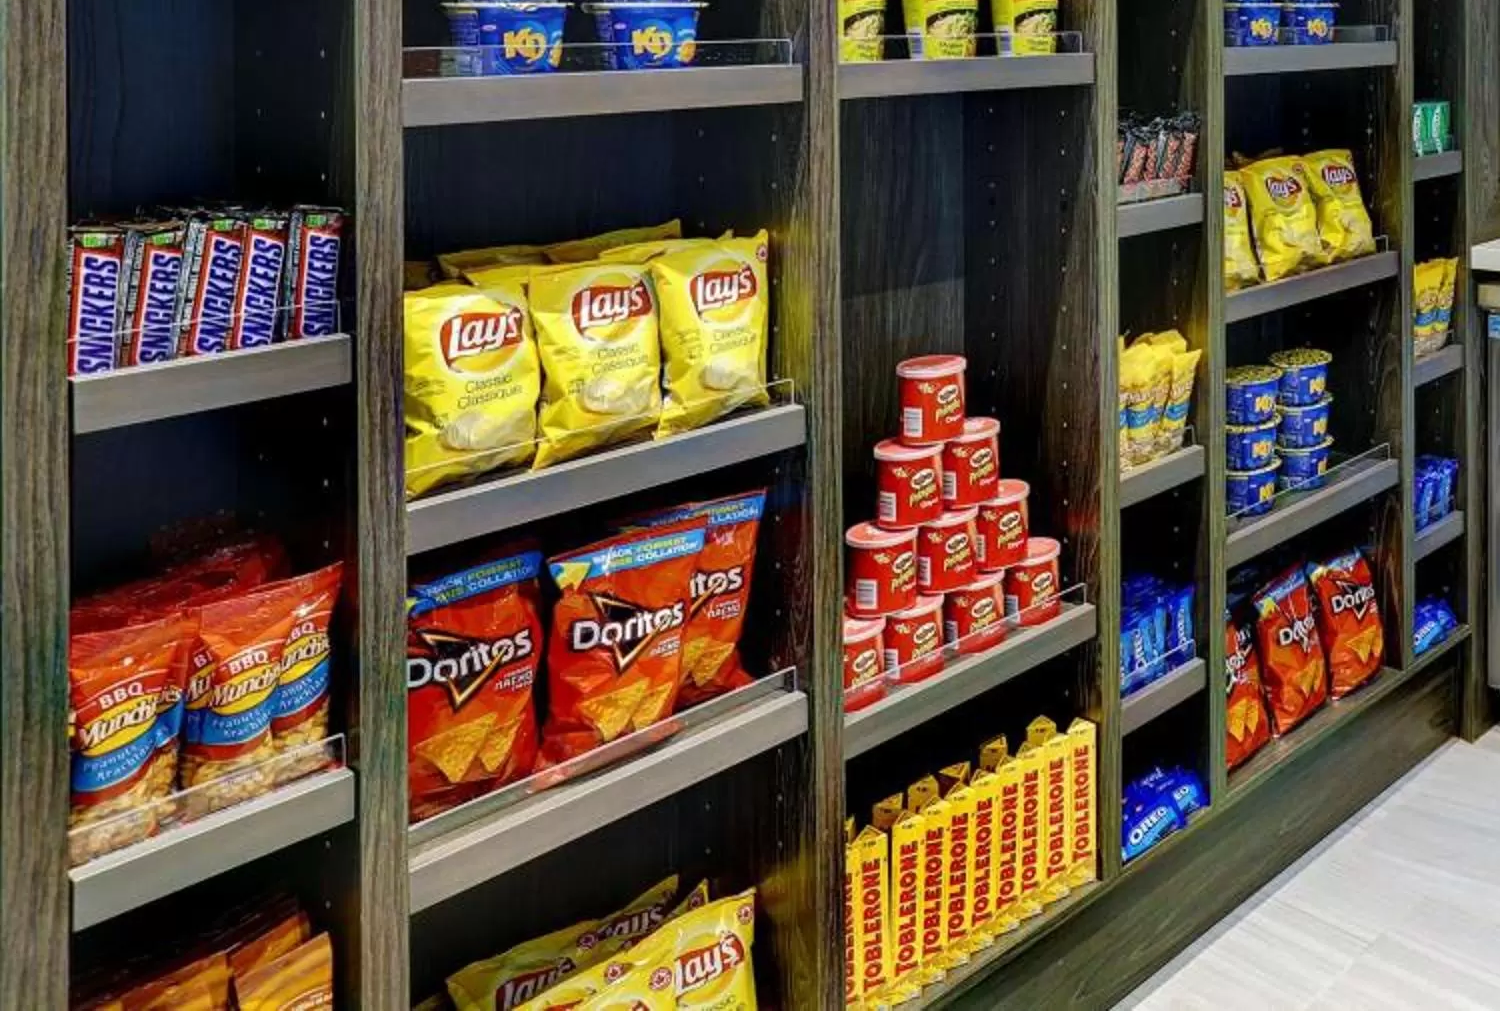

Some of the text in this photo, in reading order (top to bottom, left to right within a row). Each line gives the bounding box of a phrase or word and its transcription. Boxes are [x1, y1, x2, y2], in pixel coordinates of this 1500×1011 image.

[77, 255, 120, 374] SNICKERS
[139, 252, 181, 365] SNICKERS
[196, 238, 242, 355] SNICKERS
[240, 237, 284, 349] SNICKERS
[302, 233, 339, 337] SNICKERS
[448, 306, 524, 360] Lay's
[579, 279, 652, 328] Lay's
[695, 265, 758, 311] Lay's
[572, 601, 685, 651] Doritos
[690, 566, 743, 598] itos
[99, 681, 143, 710] BBQ
[228, 648, 269, 676] BBQ
[407, 628, 533, 689] Doritos
[996, 781, 1019, 910] TOBLERONE
[1021, 768, 1039, 893] TOBLERONE
[1047, 756, 1067, 878] TOBLERONE
[1073, 744, 1092, 863] TOBLERONE
[1129, 805, 1168, 845] OREO
[895, 840, 918, 978] TOBLERONE
[923, 826, 944, 965] TOBLERONE
[948, 812, 968, 945] TOBLERONE
[971, 796, 993, 927] TOBLERONE
[863, 858, 885, 993] TOBLERONE
